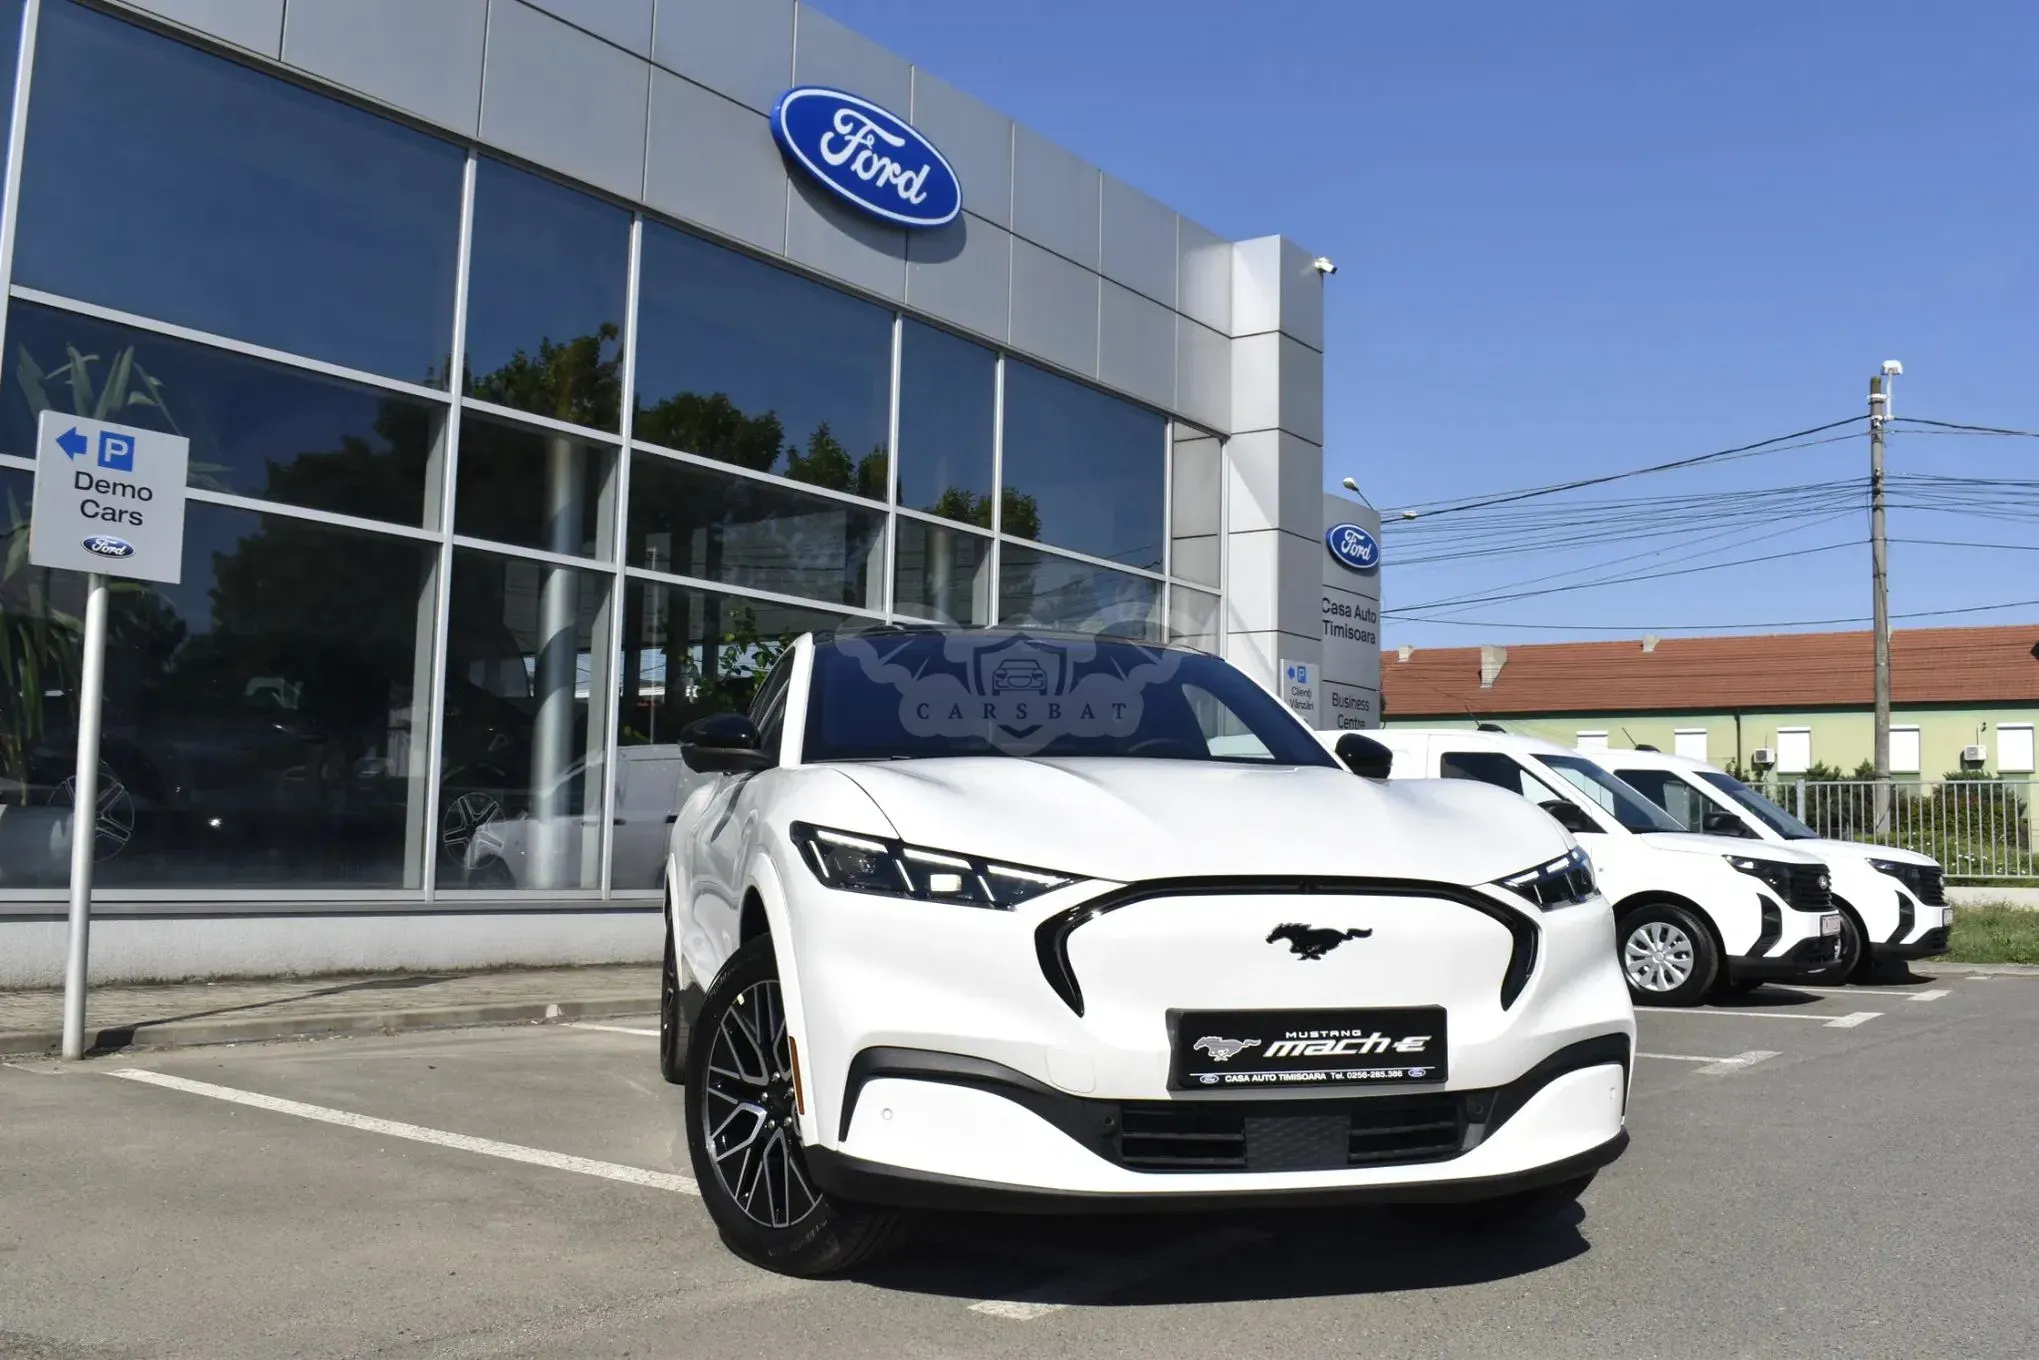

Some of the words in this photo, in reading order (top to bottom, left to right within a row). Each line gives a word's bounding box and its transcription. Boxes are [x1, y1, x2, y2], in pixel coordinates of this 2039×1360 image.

[820, 108, 931, 204] Ford
[104, 437, 129, 463] P
[74, 470, 153, 501] Demo
[80, 499, 143, 526] Cars
[92, 539, 126, 555] Ford
[1341, 529, 1371, 561] Ford
[1322, 597, 1352, 617] Casa
[1354, 604, 1377, 624] Auto
[1322, 619, 1376, 644] Timisoara
[1332, 692, 1370, 711] Business
[1337, 713, 1366, 730] Centre
[1286, 1029, 1362, 1039] MUSTANG
[1224, 1074, 1250, 1083] CASA
[1252, 1074, 1277, 1082] AUTO
[1278, 1072, 1327, 1082] TIMISOARA
[1330, 1072, 1345, 1080] Tel.
